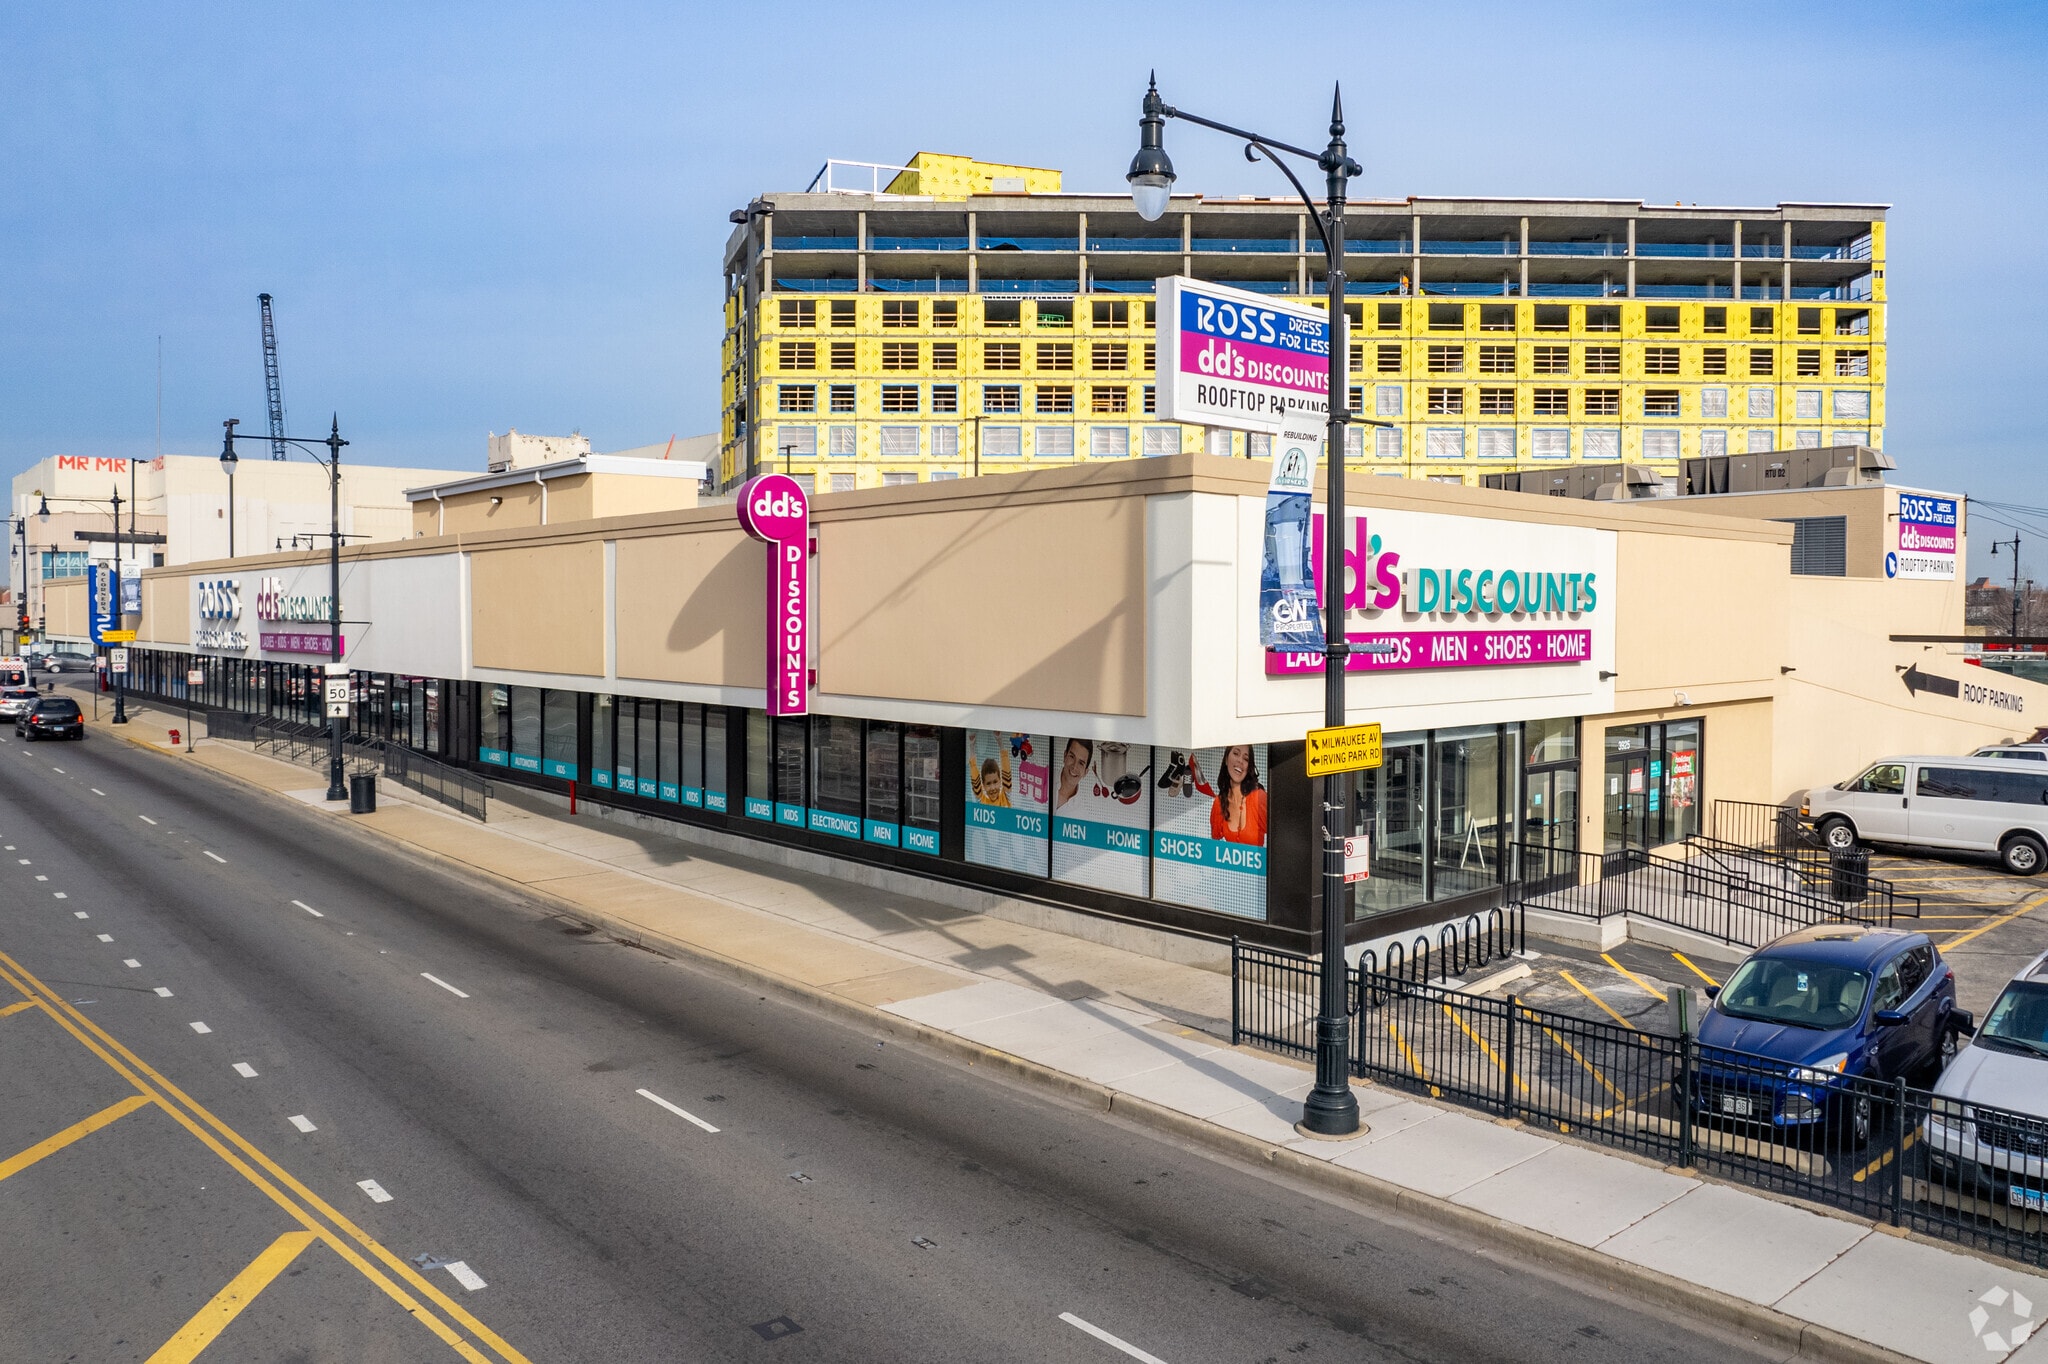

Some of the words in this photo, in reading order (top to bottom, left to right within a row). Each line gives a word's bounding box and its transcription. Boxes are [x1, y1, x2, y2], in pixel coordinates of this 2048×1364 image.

[1197, 298, 1276, 343] ROSS
[1289, 317, 1322, 336] DRESS
[1280, 333, 1301, 349] FOR
[1304, 338, 1330, 354] LESS
[1198, 338, 1245, 378] dd's
[1248, 360, 1330, 390] DISCOUNTS
[1198, 384, 1265, 412] ROOFTOP
[1283, 430, 1317, 442] REBUILDING
[58, 455, 89, 470] MR
[96, 458, 126, 473] MR
[754, 490, 803, 518] dd's
[1901, 498, 1932, 521] ROSS
[1901, 525, 1920, 549] dd's
[1920, 535, 1954, 549] DISCOUNTS
[1901, 557, 1928, 572] ROOFTOP
[1929, 559, 1954, 573] PARKING
[1417, 568, 1597, 614] DISCOUNTS
[279, 595, 333, 620] DISCOUNTS
[1272, 599, 1307, 623] GW
[786, 545, 802, 707] DISCOUNTS
[1275, 622, 1312, 632] PROPERTIES
[1372, 638, 1411, 664] KIDS
[1431, 636, 1467, 661] MEN
[1485, 635, 1531, 659] SHOES
[1547, 634, 1586, 658] HOME
[330, 688, 346, 699] 50
[1964, 683, 1988, 705] ROOF
[1989, 689, 2023, 713] PARKING
[1321, 734, 1366, 749] MILWAUKEE
[1368, 732, 1378, 743] AV
[514, 757, 538, 769] AUTOMOTIVE
[1321, 753, 1346, 766] IRVING
[1348, 750, 1367, 762] PARK
[1369, 748, 1380, 759] RD
[597, 773, 608, 784] MEN
[619, 778, 635, 790] SHOES
[640, 782, 655, 794] HOME
[663, 786, 676, 798] TOYS
[686, 791, 698, 803] KIDS
[707, 795, 725, 808] BABIES
[749, 802, 770, 816] LADIES
[783, 808, 799, 822] KIDS
[812, 813, 857, 834] ELECTRONICS
[973, 807, 996, 825] KIDS
[1015, 814, 1042, 833] TOYS
[873, 825, 891, 840] MEN
[909, 832, 934, 849] HOME
[1062, 822, 1086, 841] MEN
[1107, 829, 1141, 850] HOME
[1160, 837, 1202, 860] SHOES
[1215, 846, 1262, 869] LADIES
